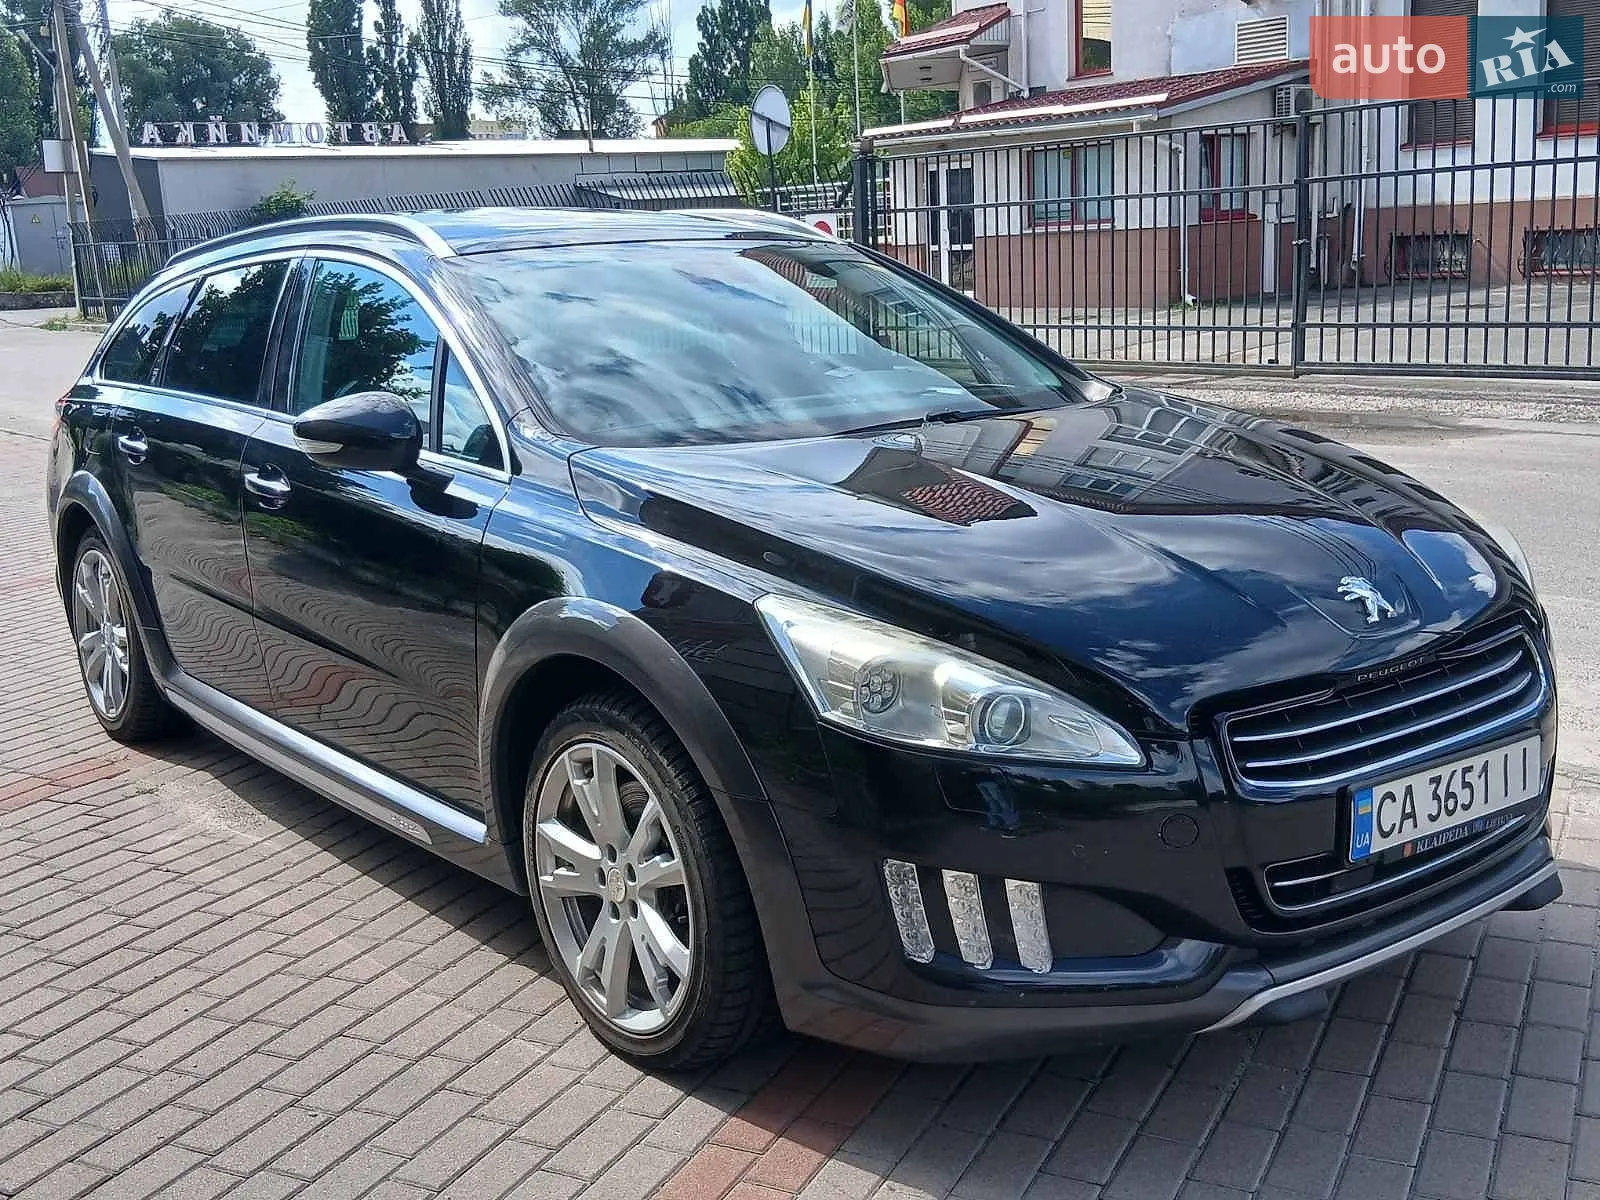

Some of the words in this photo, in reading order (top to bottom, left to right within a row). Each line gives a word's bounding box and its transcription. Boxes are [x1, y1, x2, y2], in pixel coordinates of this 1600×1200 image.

[1356, 656, 1424, 682] PEUGEOT
[1376, 784, 1418, 839] CA
[1427, 760, 1489, 823] 3651
[1355, 834, 1370, 848] UA
